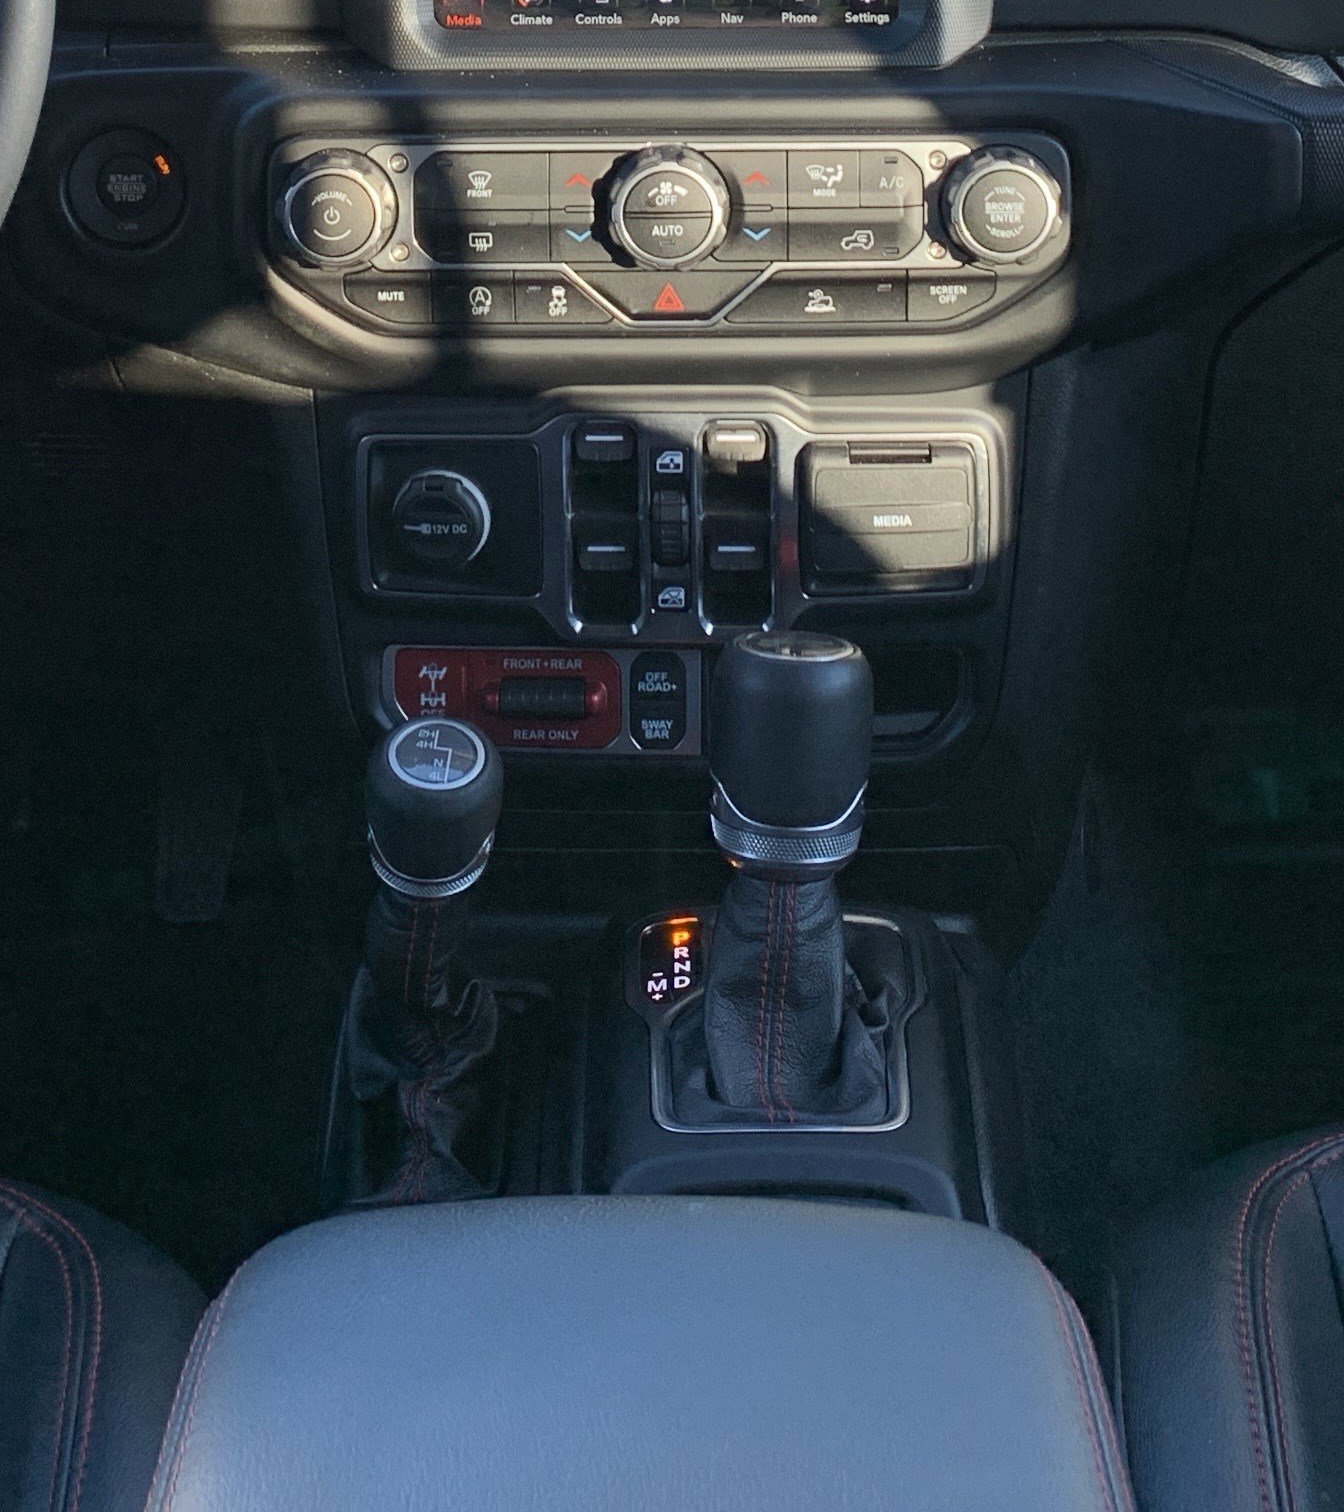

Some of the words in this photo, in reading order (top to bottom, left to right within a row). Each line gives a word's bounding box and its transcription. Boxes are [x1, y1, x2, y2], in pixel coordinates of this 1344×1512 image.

[446, 13, 483, 26] Media
[510, 13, 554, 26] Climate
[574, 13, 623, 26] Controls
[650, 13, 681, 28] Apps
[720, 12, 744, 24] Nav
[781, 11, 818, 24] Phone
[844, 11, 890, 26] Settings
[879, 176, 905, 190] A/C
[467, 188, 493, 199] FRONT
[812, 188, 837, 198] MODE
[655, 193, 678, 207] OFF
[651, 224, 684, 238] AUTO
[377, 290, 405, 302] MUTE
[929, 284, 968, 296] SCREEN
[937, 294, 958, 304] OFF
[471, 306, 491, 316] OFF
[548, 306, 568, 317] OFF
[872, 514, 913, 528] MEDIA
[432, 523, 450, 534] 12V
[451, 523, 468, 534] DC
[641, 719, 674, 730] SWAY
[513, 729, 546, 740] REAR
[548, 729, 580, 740] ONLY
[645, 729, 670, 740] BAR
[415, 740, 434, 749] 4H
[433, 758, 444, 768] N
[673, 930, 690, 946] P
[673, 946, 690, 960] R
[673, 960, 691, 974] N
[646, 978, 668, 993] M
[673, 975, 691, 989] D
